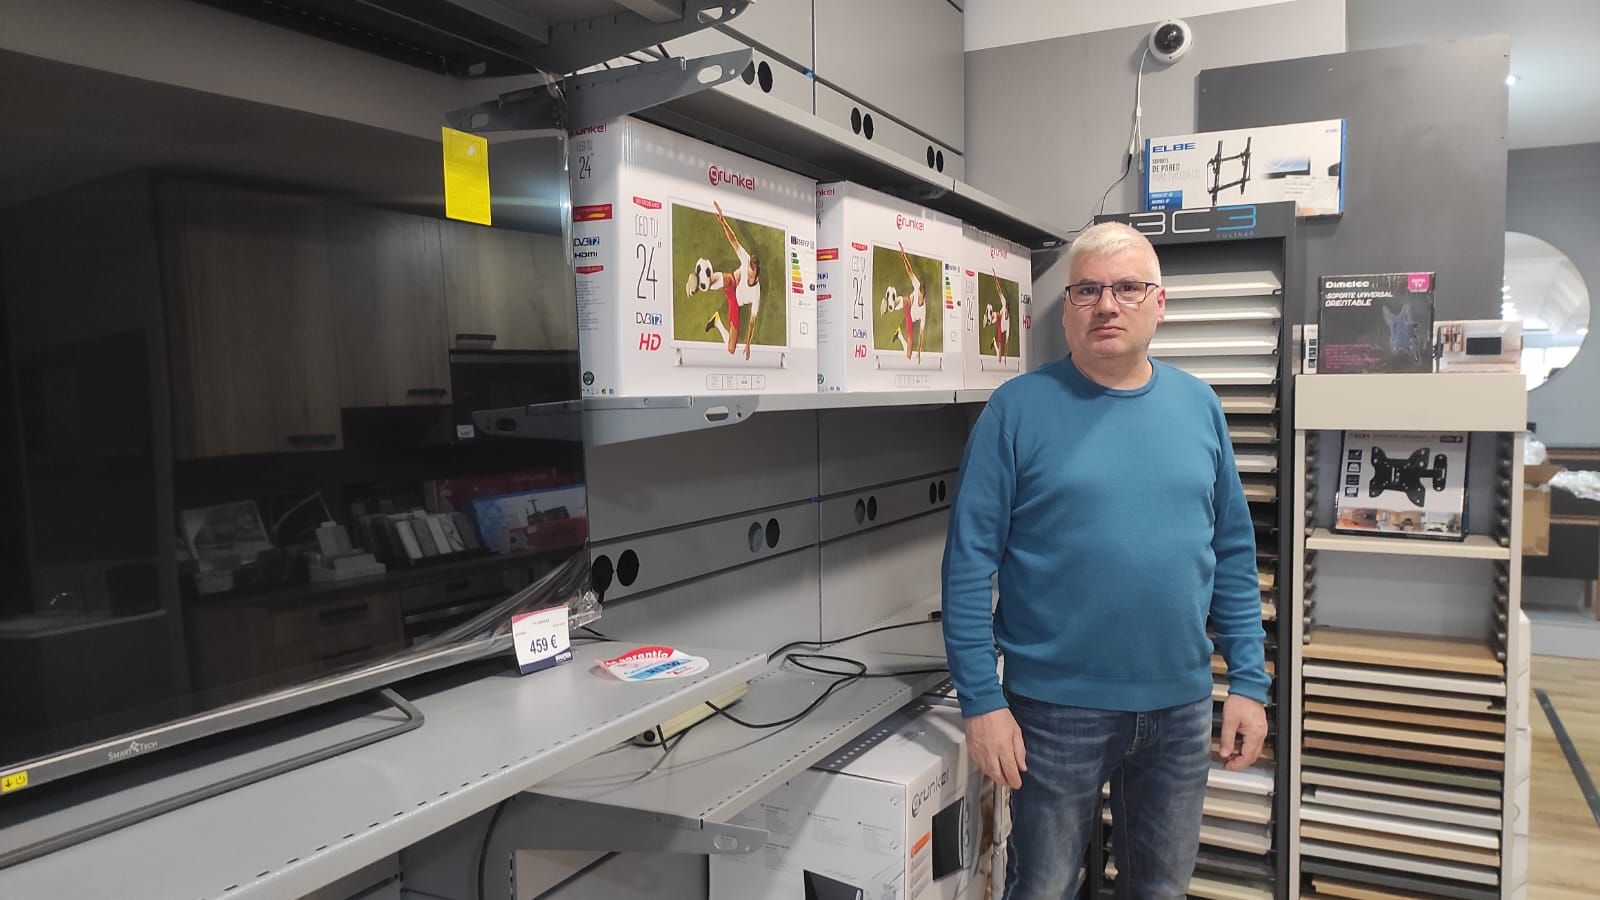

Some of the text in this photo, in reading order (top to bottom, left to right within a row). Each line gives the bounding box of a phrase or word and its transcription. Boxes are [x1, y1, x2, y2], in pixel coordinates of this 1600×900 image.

[567, 123, 607, 140] unkel
[1152, 142, 1196, 153] ELBE
[1152, 165, 1159, 173] DE
[635, 214, 648, 237] LED
[639, 332, 662, 351] HD
[854, 344, 867, 358] HD
[530, 634, 557, 655] 459 €
